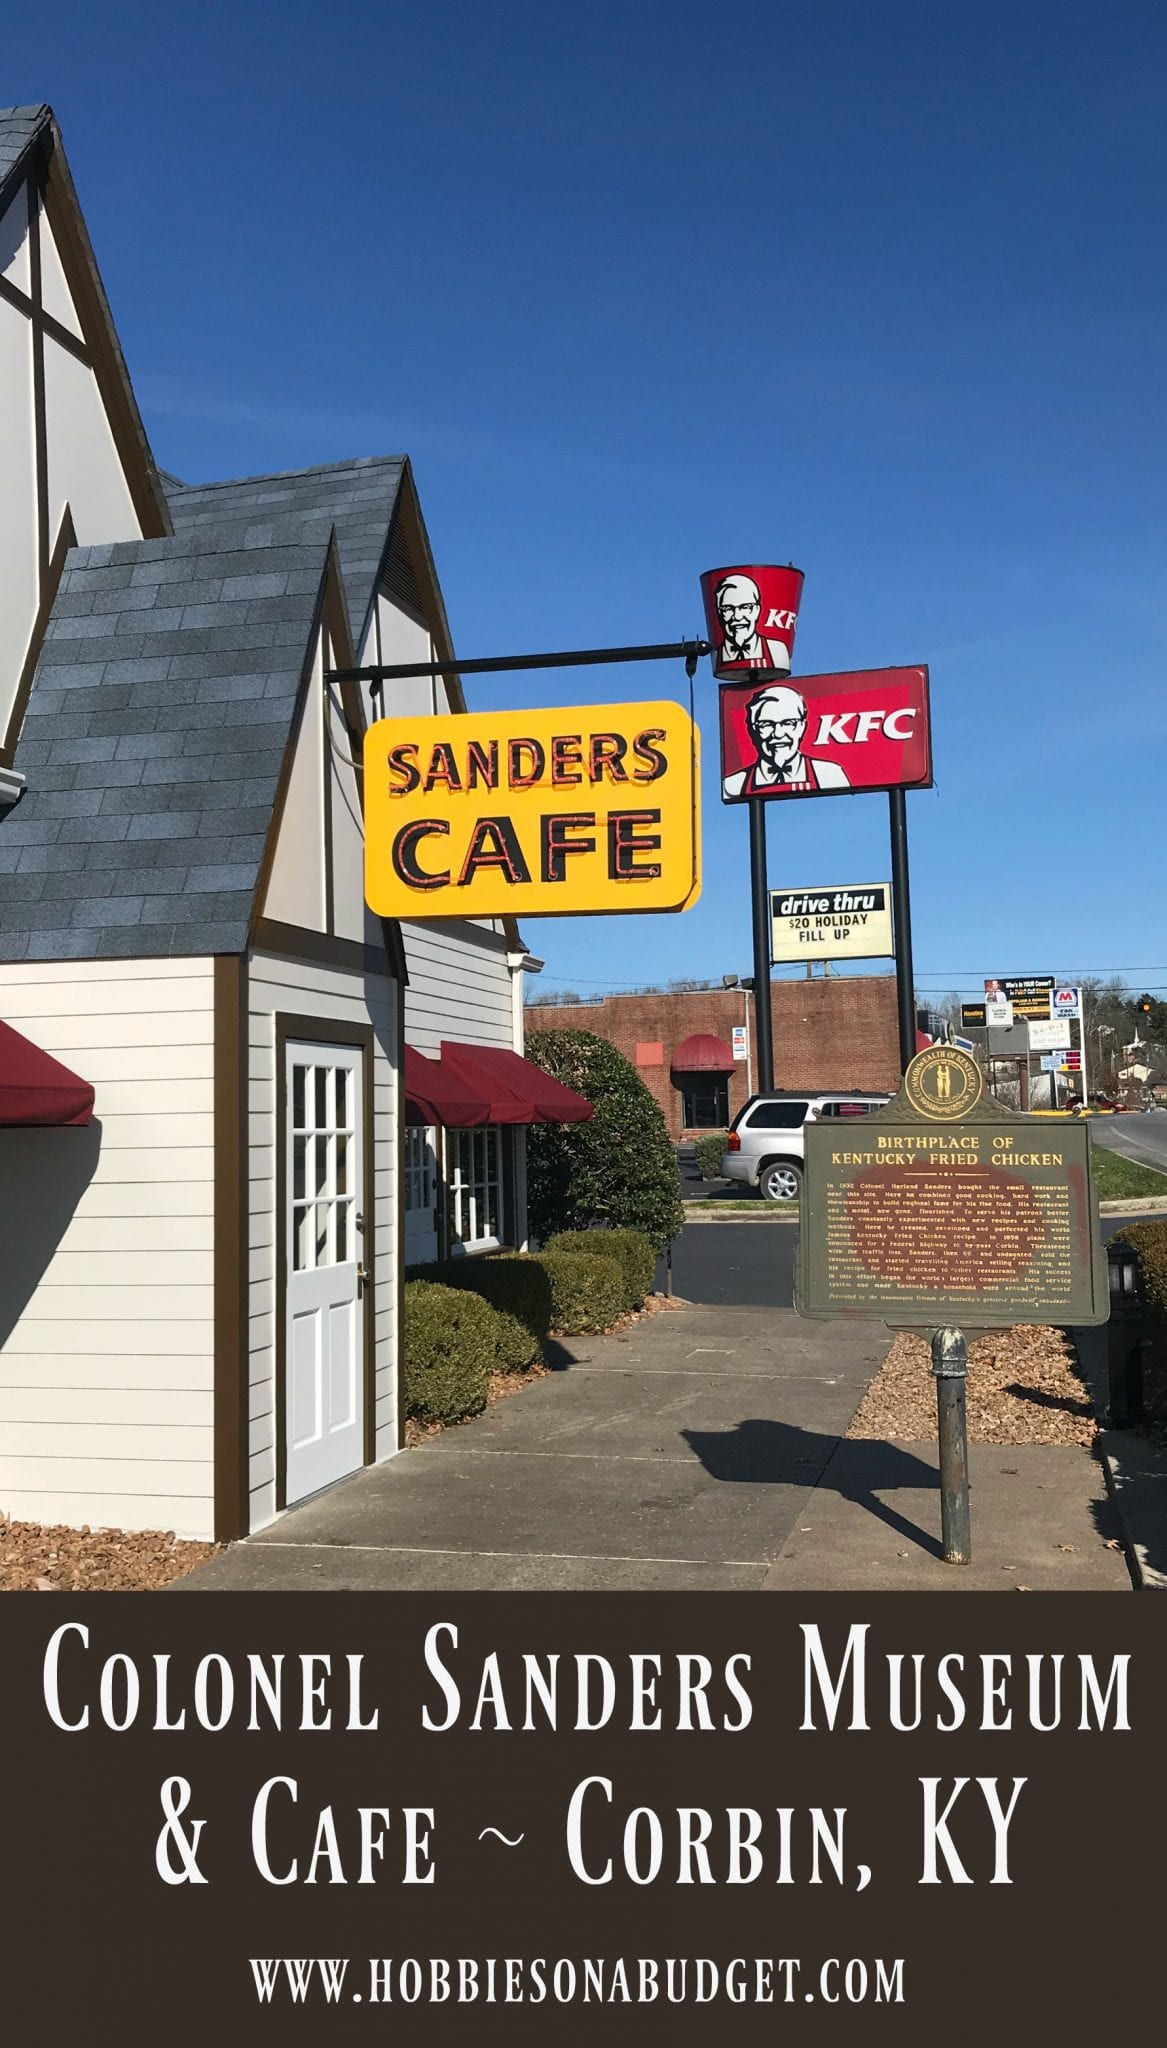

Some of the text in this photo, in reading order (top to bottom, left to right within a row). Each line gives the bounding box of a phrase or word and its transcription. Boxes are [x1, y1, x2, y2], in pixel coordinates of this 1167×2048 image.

[813, 708, 917, 746] KFC
[388, 729, 668, 794] SANDERS
[392, 808, 662, 889] CAFE
[780, 892, 875, 915] drive thru
[789, 913, 868, 929] $20 HOLIDAY
[799, 928, 850, 942] FILL UP
[912, 1050, 946, 1098] COMMONWEALTH
[955, 1055, 976, 1094] KENTUCKY
[877, 1136, 1014, 1150] BIRTHPLACE OF
[831, 1153, 1063, 1166] KENTUCKY FRIED CHICKEN
